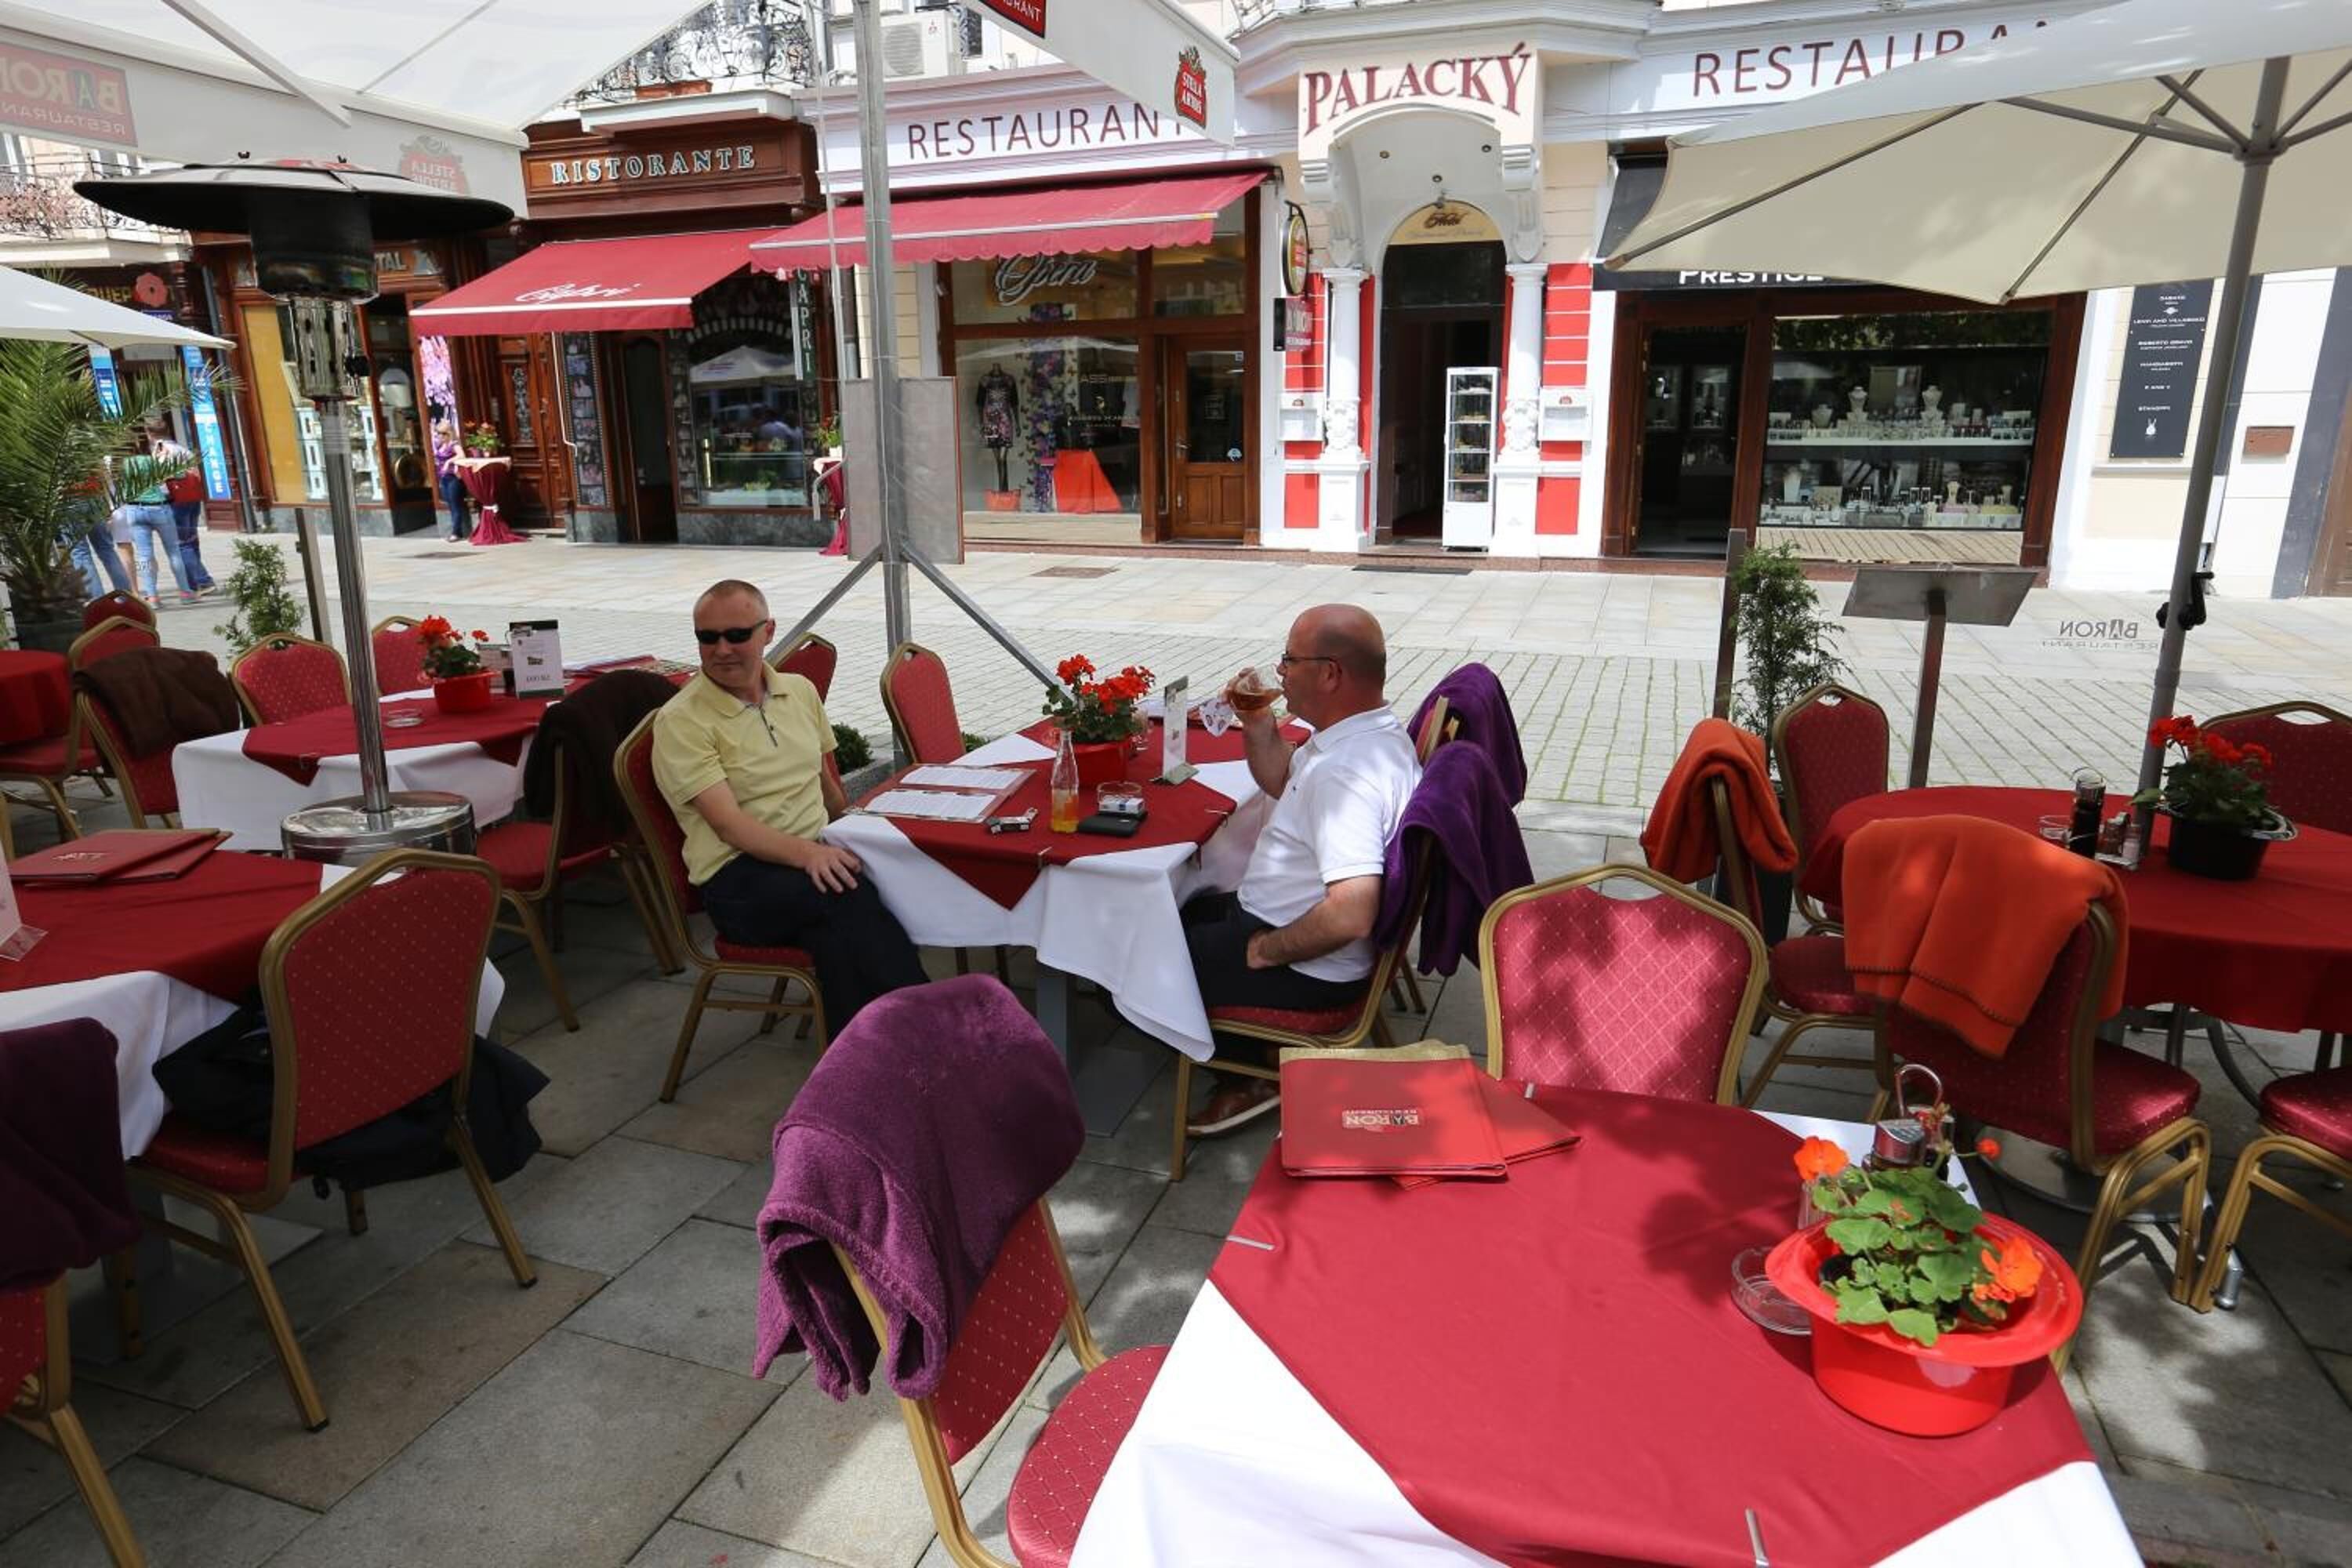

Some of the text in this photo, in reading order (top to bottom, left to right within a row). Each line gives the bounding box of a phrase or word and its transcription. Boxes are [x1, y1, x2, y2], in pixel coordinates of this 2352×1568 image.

[1693, 21, 2045, 96] RESTAUR
[1305, 42, 1530, 136] PALACKÝ
[551, 146, 755, 184] RISTORANTE
[1679, 270, 1824, 285] PRESTI
[797, 267, 812, 372] CAPRI
[1345, 1114, 1418, 1126] BARON
